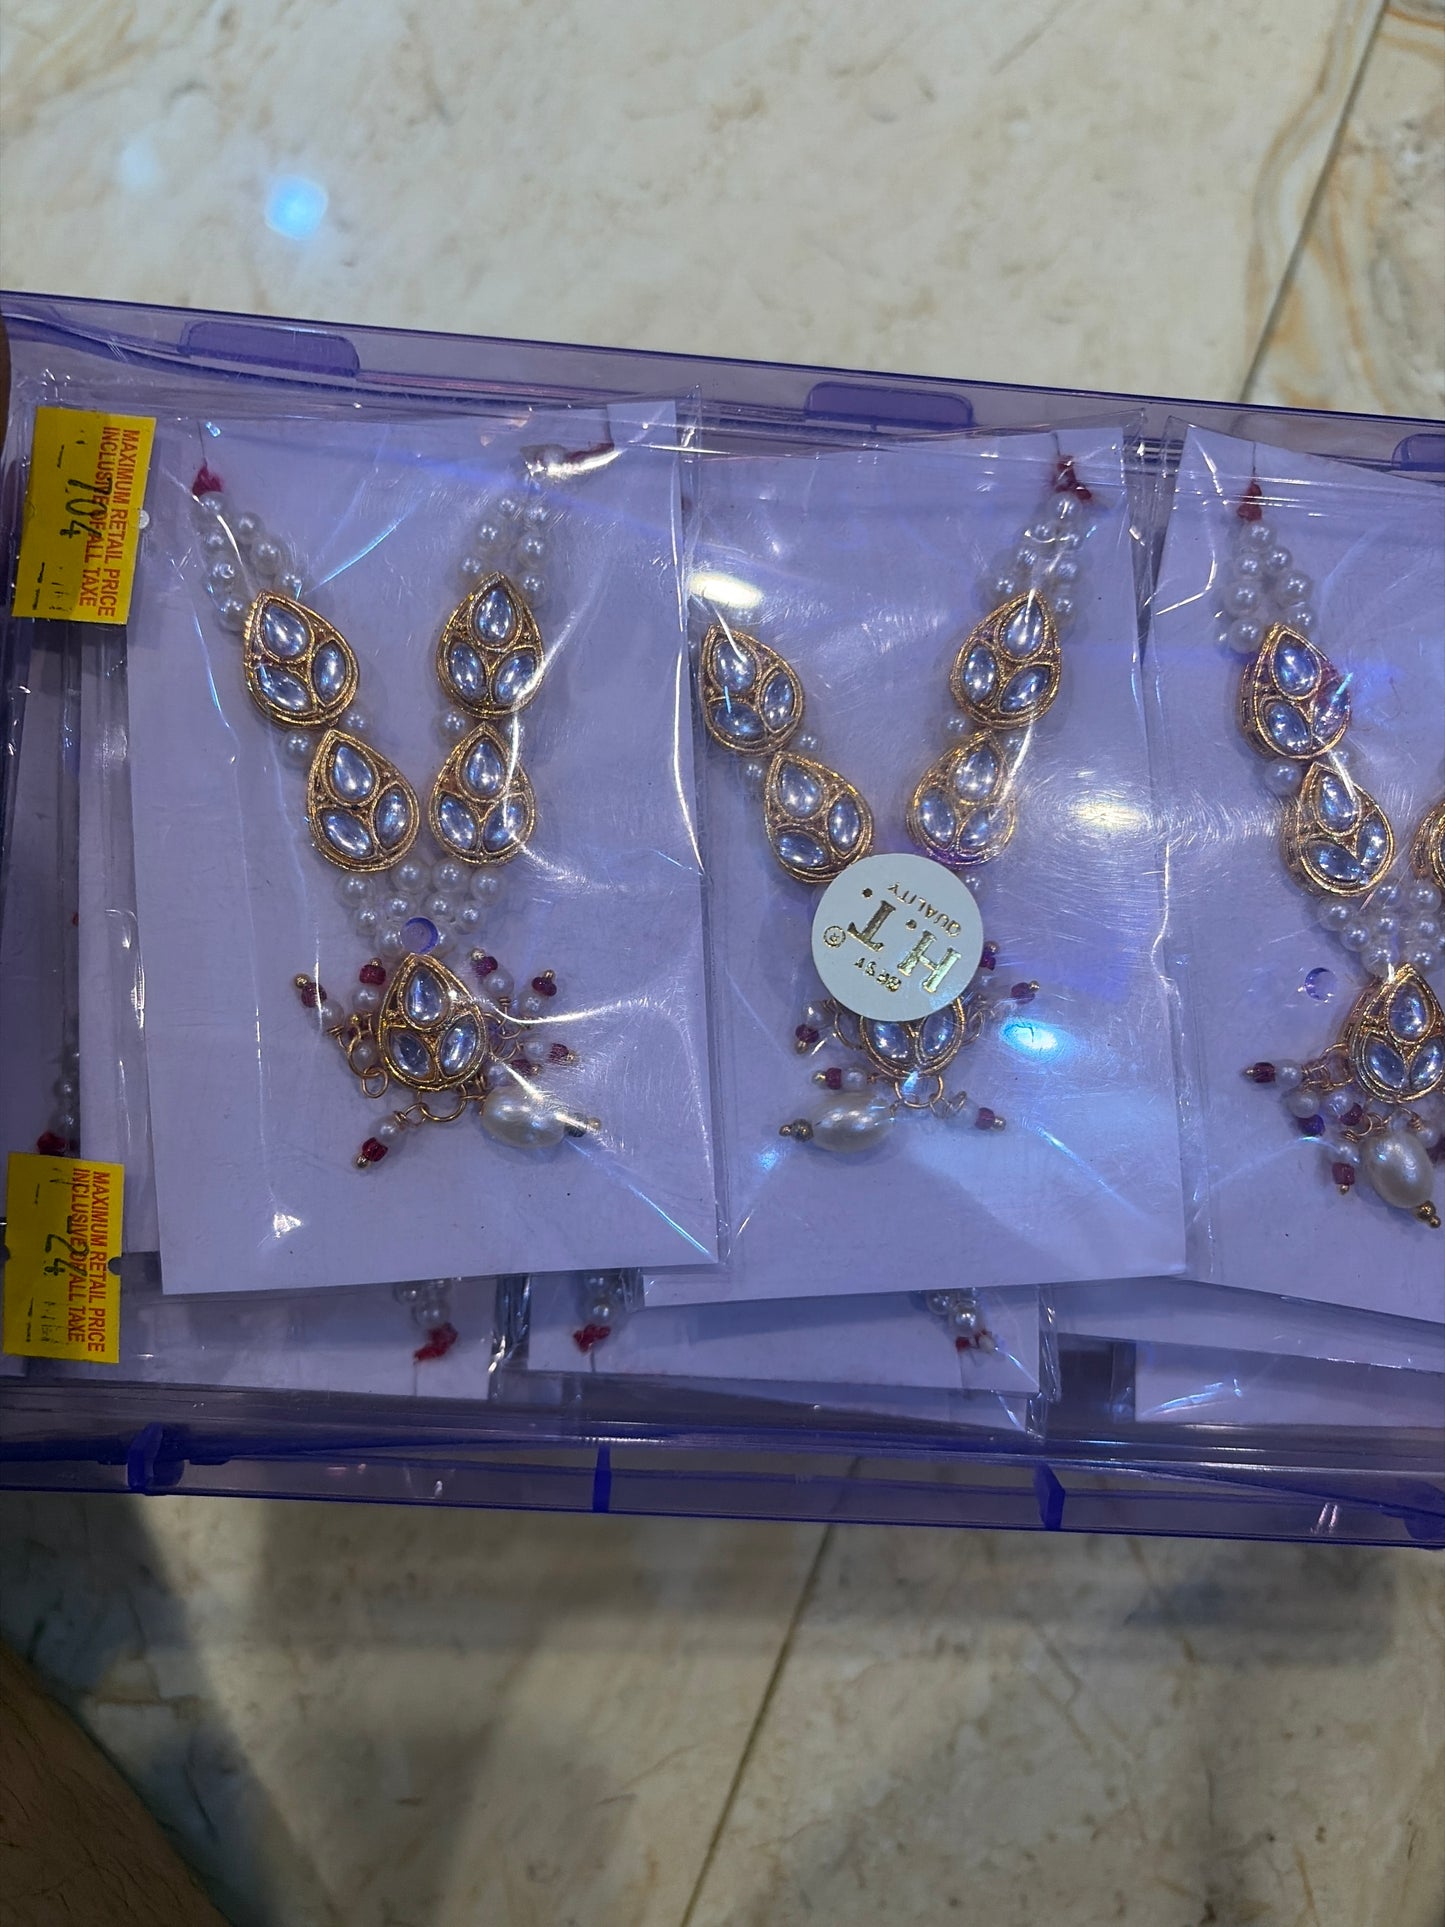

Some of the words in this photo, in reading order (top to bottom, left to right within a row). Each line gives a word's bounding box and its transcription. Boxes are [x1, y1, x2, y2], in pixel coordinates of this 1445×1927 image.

[113, 429, 140, 504] MAXIMUM
[84, 534, 104, 563] ALL
[104, 509, 128, 563] RETAIL
[79, 568, 100, 607] TAXE
[98, 569, 120, 617] PRICE
[888, 882, 961, 938] QUALITY
[71, 1168, 88, 1247] INCLUSIVE
[91, 1171, 110, 1247] MAXIMUM
[68, 1273, 86, 1301] ALL
[88, 1251, 106, 1303] RETAIL
[68, 1306, 86, 1342] TAXE
[87, 1307, 105, 1352] PRICE
